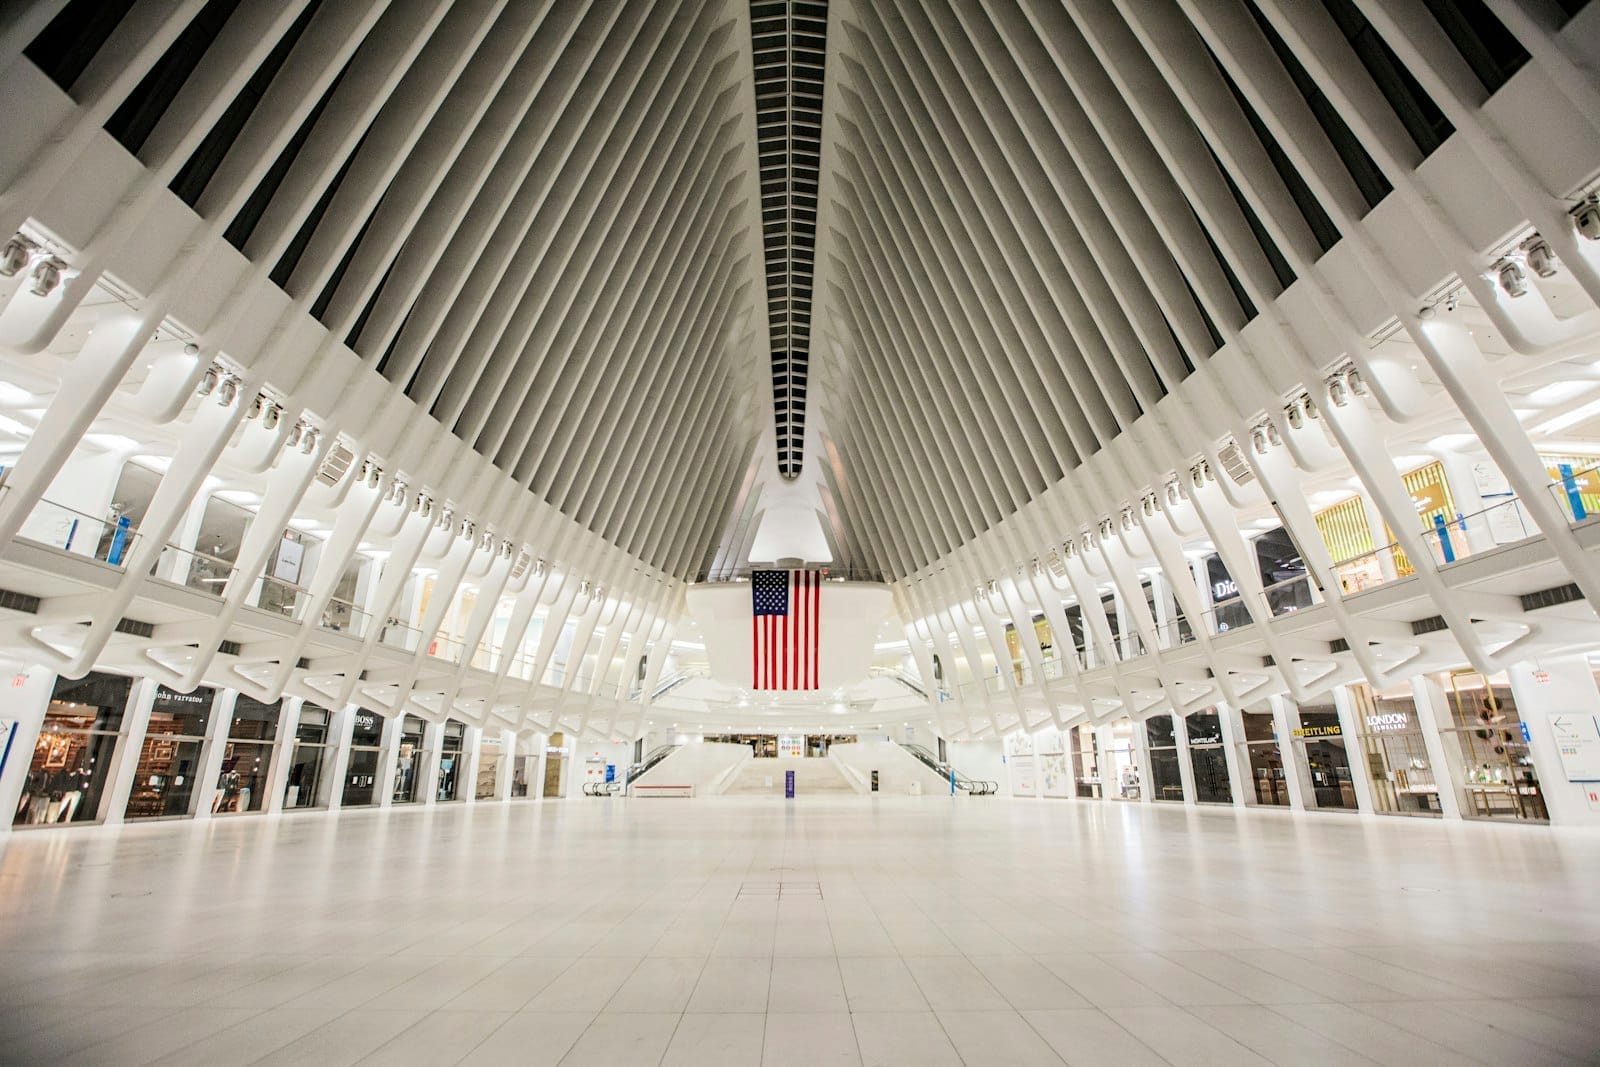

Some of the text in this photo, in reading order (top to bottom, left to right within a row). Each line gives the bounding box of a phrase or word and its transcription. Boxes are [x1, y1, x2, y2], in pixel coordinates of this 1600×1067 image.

[1215, 581, 1237, 597] Dio
[355, 715, 373, 724] BOSS
[1367, 713, 1408, 726] LONDON
[1293, 726, 1341, 737] BREITLING
